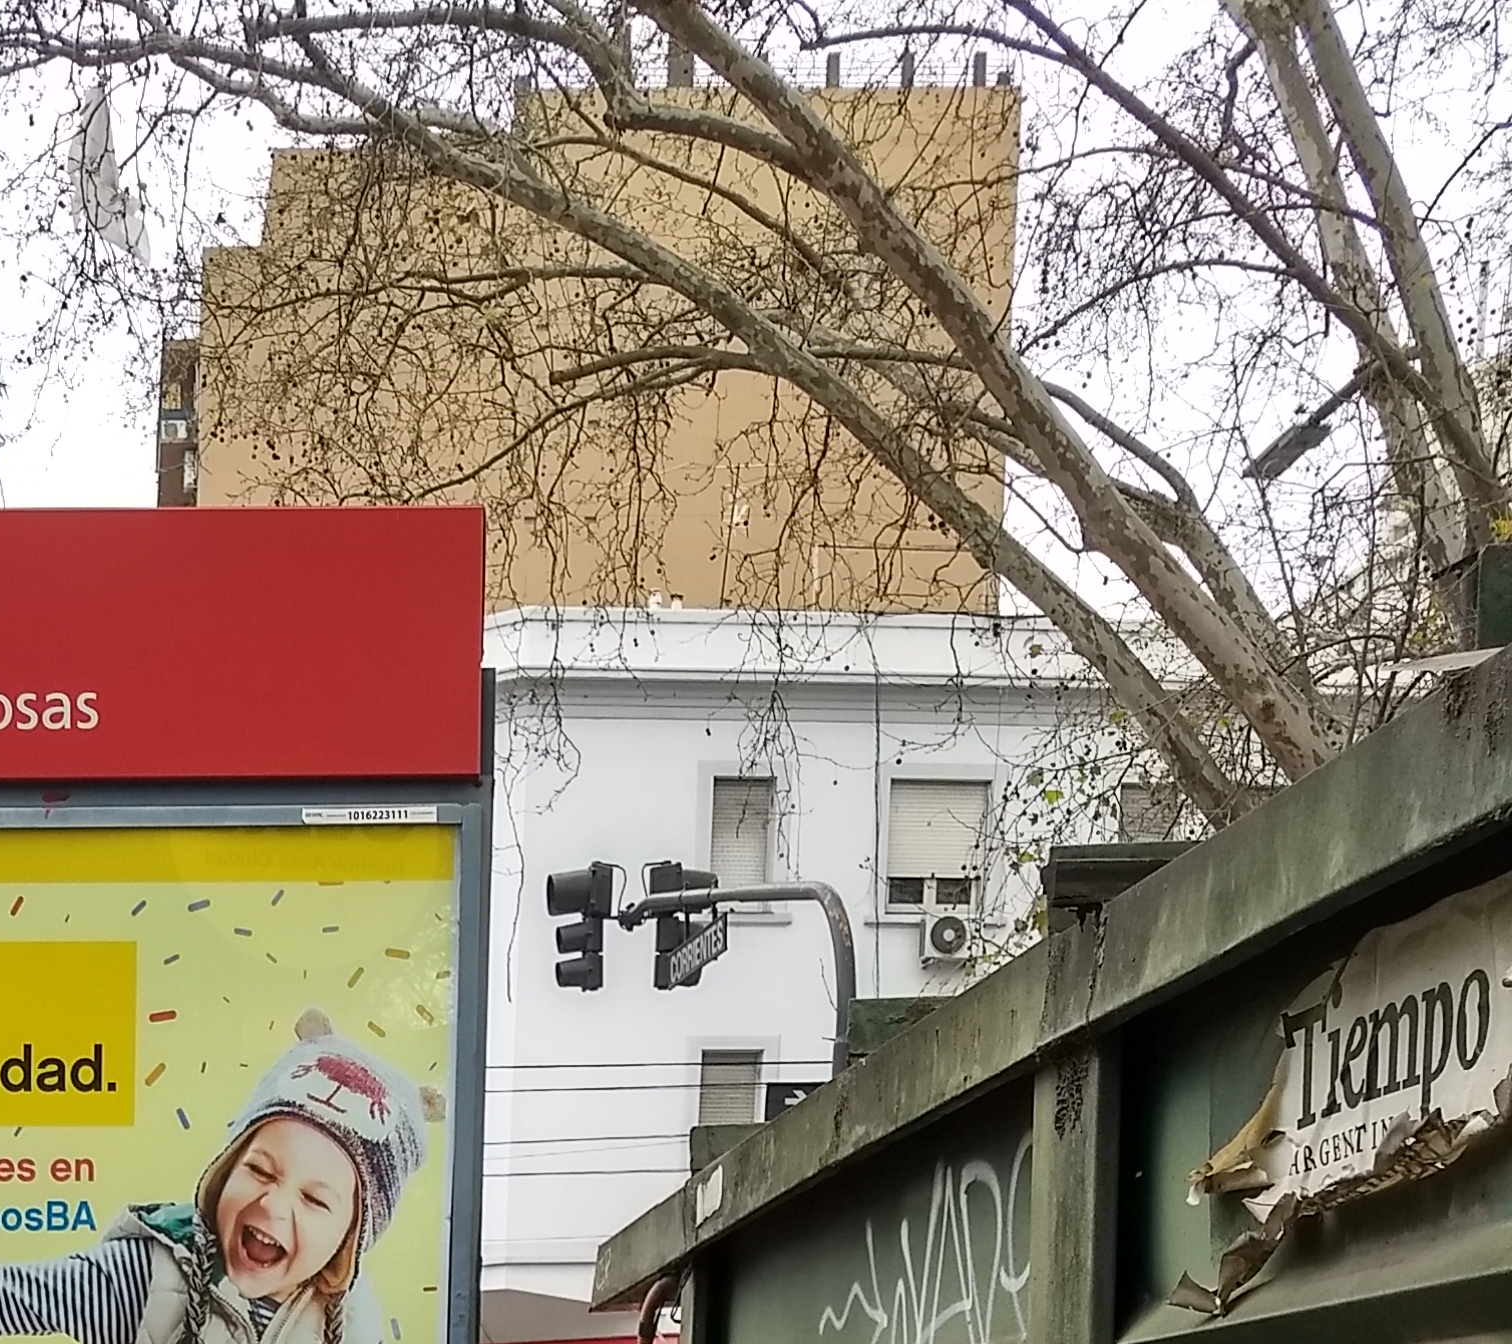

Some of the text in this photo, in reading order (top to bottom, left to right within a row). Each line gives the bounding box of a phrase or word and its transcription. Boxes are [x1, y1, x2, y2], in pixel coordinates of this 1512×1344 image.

[348, 810, 408, 821] 1016223111
[671, 920, 724, 983] CORRIENTES
[1284, 968, 1490, 1131] Tiempo
[51, 1159, 93, 1181] en
[1288, 1117, 1394, 1176] ARGENTIN
